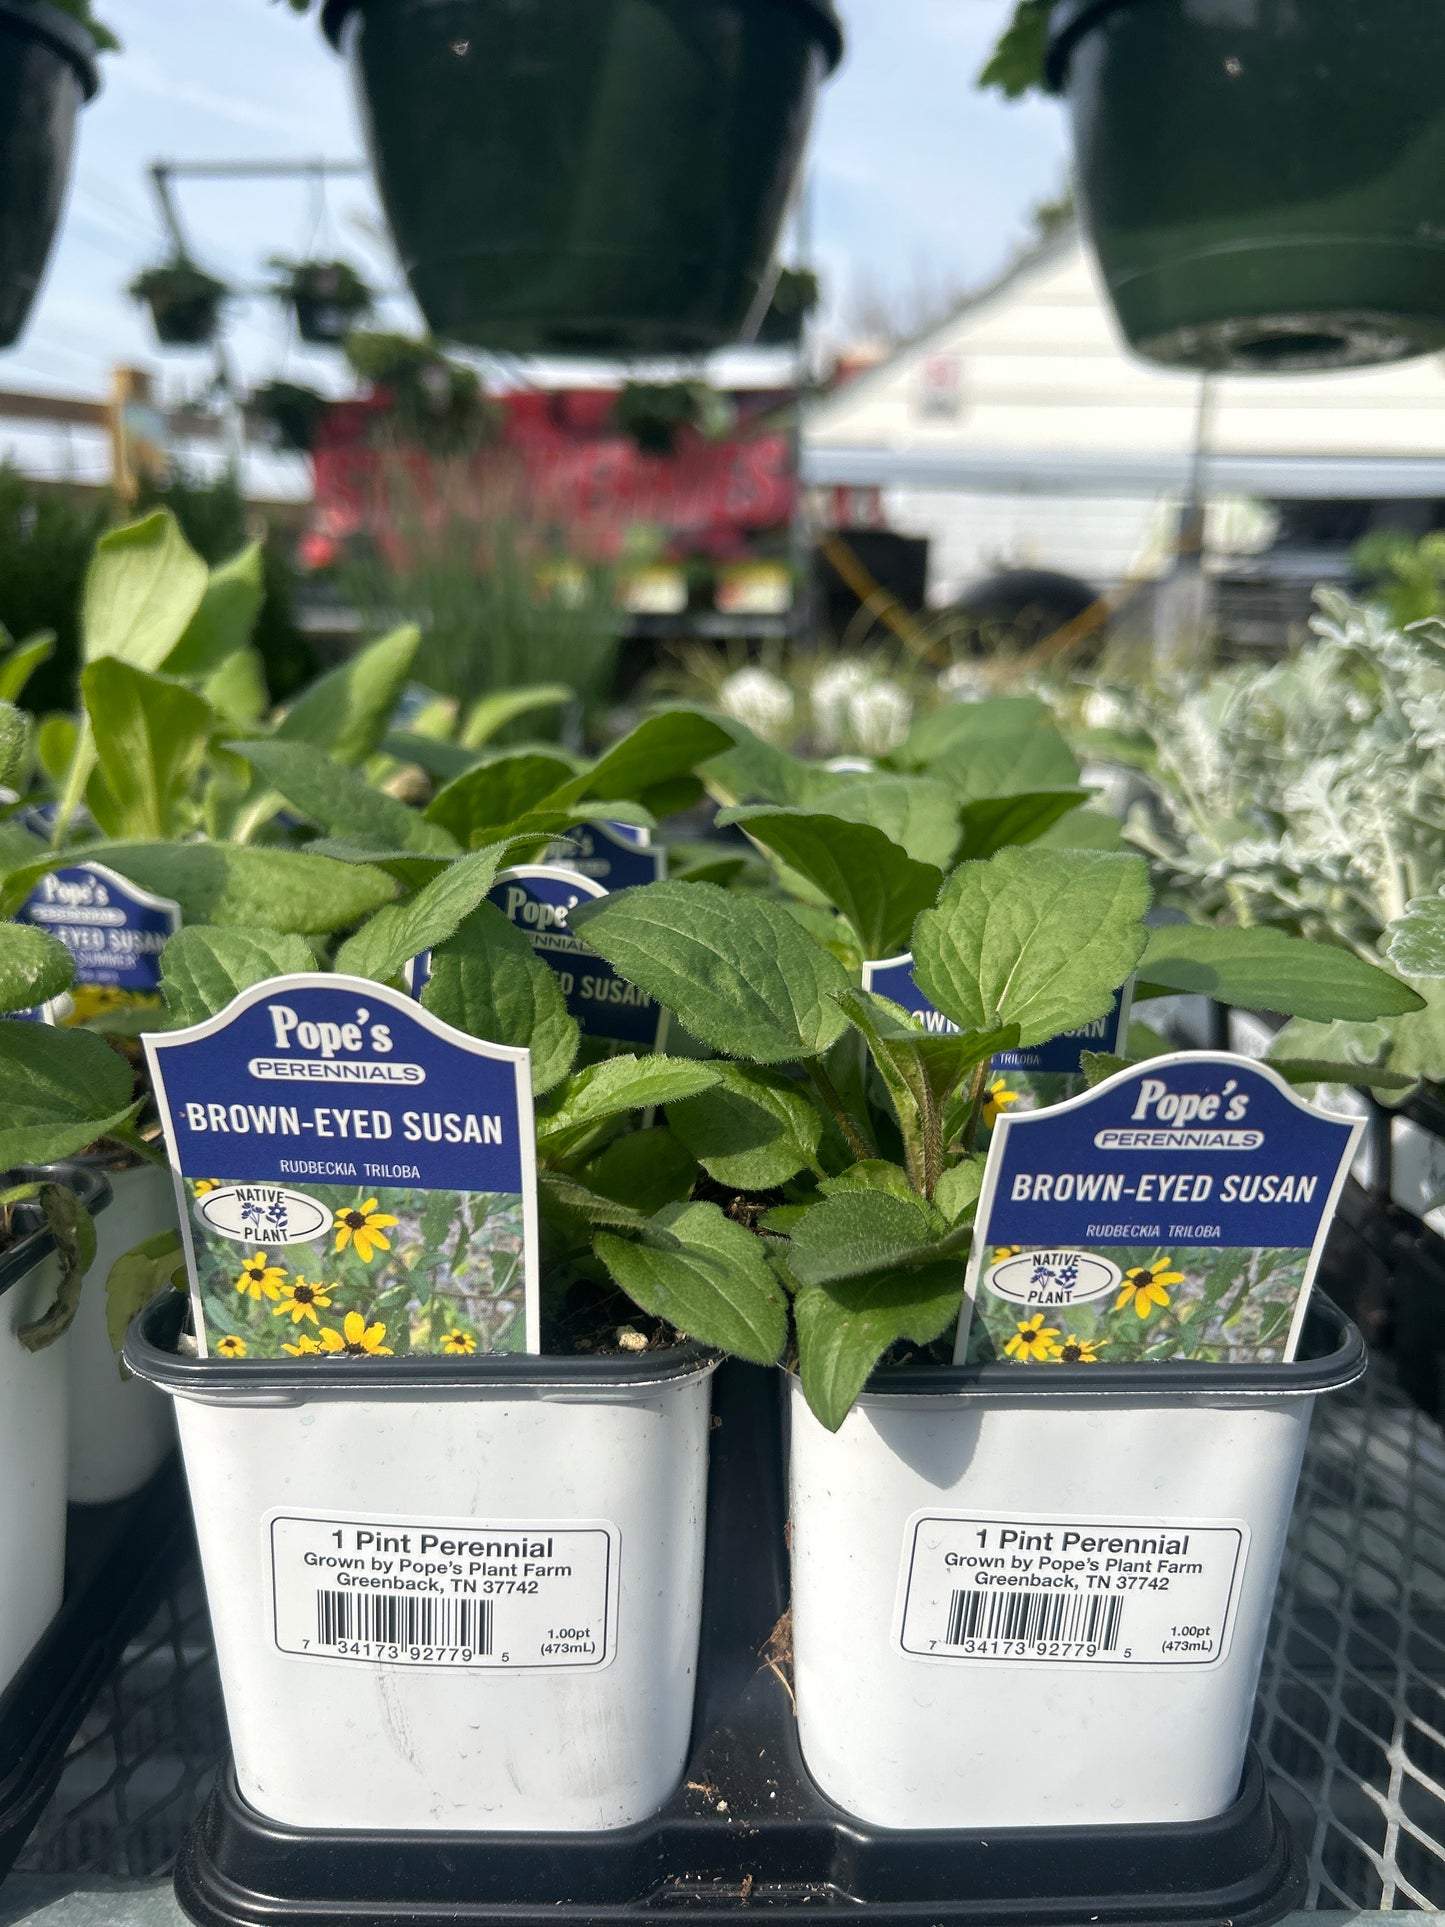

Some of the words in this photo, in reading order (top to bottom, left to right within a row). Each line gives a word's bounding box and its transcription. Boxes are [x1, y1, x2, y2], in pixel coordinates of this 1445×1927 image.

[268, 1005, 393, 1058] Pope's
[1000, 1052, 1041, 1066] TRILOBA
[257, 1063, 420, 1081] PERENNIALS
[1131, 1079, 1249, 1127] Pope's
[185, 1103, 392, 1139] BROWN-EYED
[403, 1111, 503, 1144] SUSAN
[1101, 1133, 1258, 1147] PERENNIALS
[280, 1160, 356, 1176] RUDBECKIA
[364, 1163, 420, 1179] TRILOBA
[236, 1189, 285, 1204] NATIVE
[1011, 1174, 1213, 1202] BROWN-EYED
[1220, 1175, 1317, 1203] SUSAN
[244, 1227, 288, 1242] PLANT
[1086, 1225, 1160, 1238] RUDBECKIA
[1168, 1226, 1221, 1238] TRILOBA
[1033, 1253, 1081, 1267] NATIVE
[1027, 1290, 1073, 1304] PLANT
[332, 1529, 344, 1549] 1
[357, 1531, 411, 1552] Pint
[421, 1534, 553, 1558] Perennial
[977, 1529, 987, 1548] 1
[999, 1530, 1053, 1551] Pint
[1062, 1532, 1189, 1555] Perennial
[303, 1552, 365, 1570] Grown
[372, 1556, 392, 1574] by
[400, 1558, 463, 1578] Pope's
[469, 1561, 518, 1577] Plant
[523, 1563, 572, 1577] Farm
[944, 1553, 1004, 1569] Grown
[1011, 1555, 1032, 1572] by
[1038, 1556, 1099, 1575] Pope's
[1106, 1559, 1152, 1573] Plant
[1158, 1560, 1202, 1574] Farm
[336, 1573, 444, 1593] Greenback,
[450, 1579, 477, 1593] TN
[483, 1580, 539, 1594] 37742
[974, 1572, 1079, 1589] Greenback,
[1086, 1575, 1111, 1589] TN
[1116, 1576, 1169, 1591] 37742
[548, 1628, 591, 1641] 1.00pt
[1170, 1626, 1210, 1638] 1.00pt
[302, 1640, 310, 1649] 7
[338, 1641, 398, 1659] 34173
[410, 1647, 472, 1662] 92779
[501, 1652, 510, 1662] 5
[540, 1642, 596, 1655] (473mL)
[929, 1640, 937, 1650] 7
[965, 1639, 1025, 1655] 34173
[1037, 1643, 1096, 1657] 92779
[1123, 1648, 1131, 1658] 5
[1161, 1640, 1213, 1653] (473mL)
